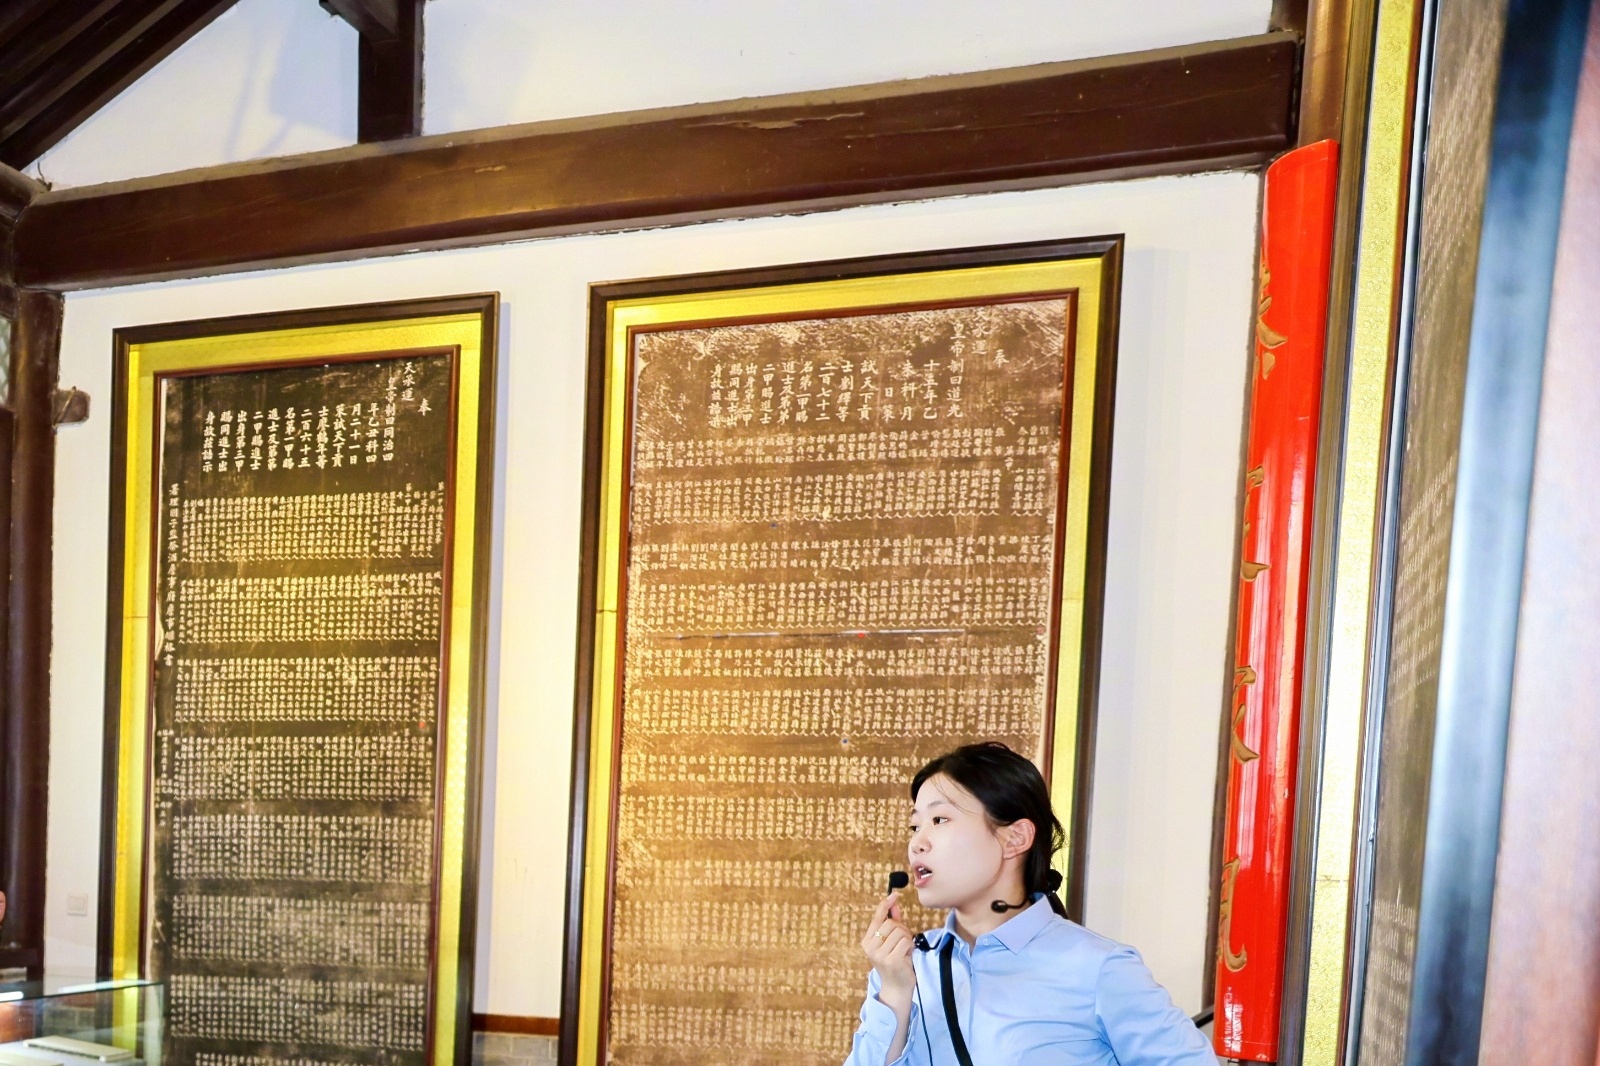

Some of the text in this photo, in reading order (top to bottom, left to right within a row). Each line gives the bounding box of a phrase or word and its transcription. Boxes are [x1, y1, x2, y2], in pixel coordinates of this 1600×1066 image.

[401, 361, 416, 401] 天承運
[741, 363, 758, 426] 出身第三甲
[759, 363, 775, 424] 二甲賜進士
[796, 361, 814, 423] 名第一甲賜
[815, 362, 838, 421] 二百七十二
[857, 359, 879, 420] 試天下貢
[923, 359, 940, 419] 十五年乙
[947, 322, 966, 418] 皇帝制曰道光
[218, 410, 233, 472] 賜同進士出
[234, 410, 247, 472] 出身第三甲
[250, 411, 264, 470] 二甲賜進士
[283, 407, 296, 469] 名第一甲賜
[298, 408, 312, 468] 二百六十五
[332, 404, 347, 467] 策試天下貢
[348, 403, 361, 465] 月二十一日
[365, 402, 380, 463] 年乙丑科四
[383, 377, 397, 461] 皇帝制曰同治四
